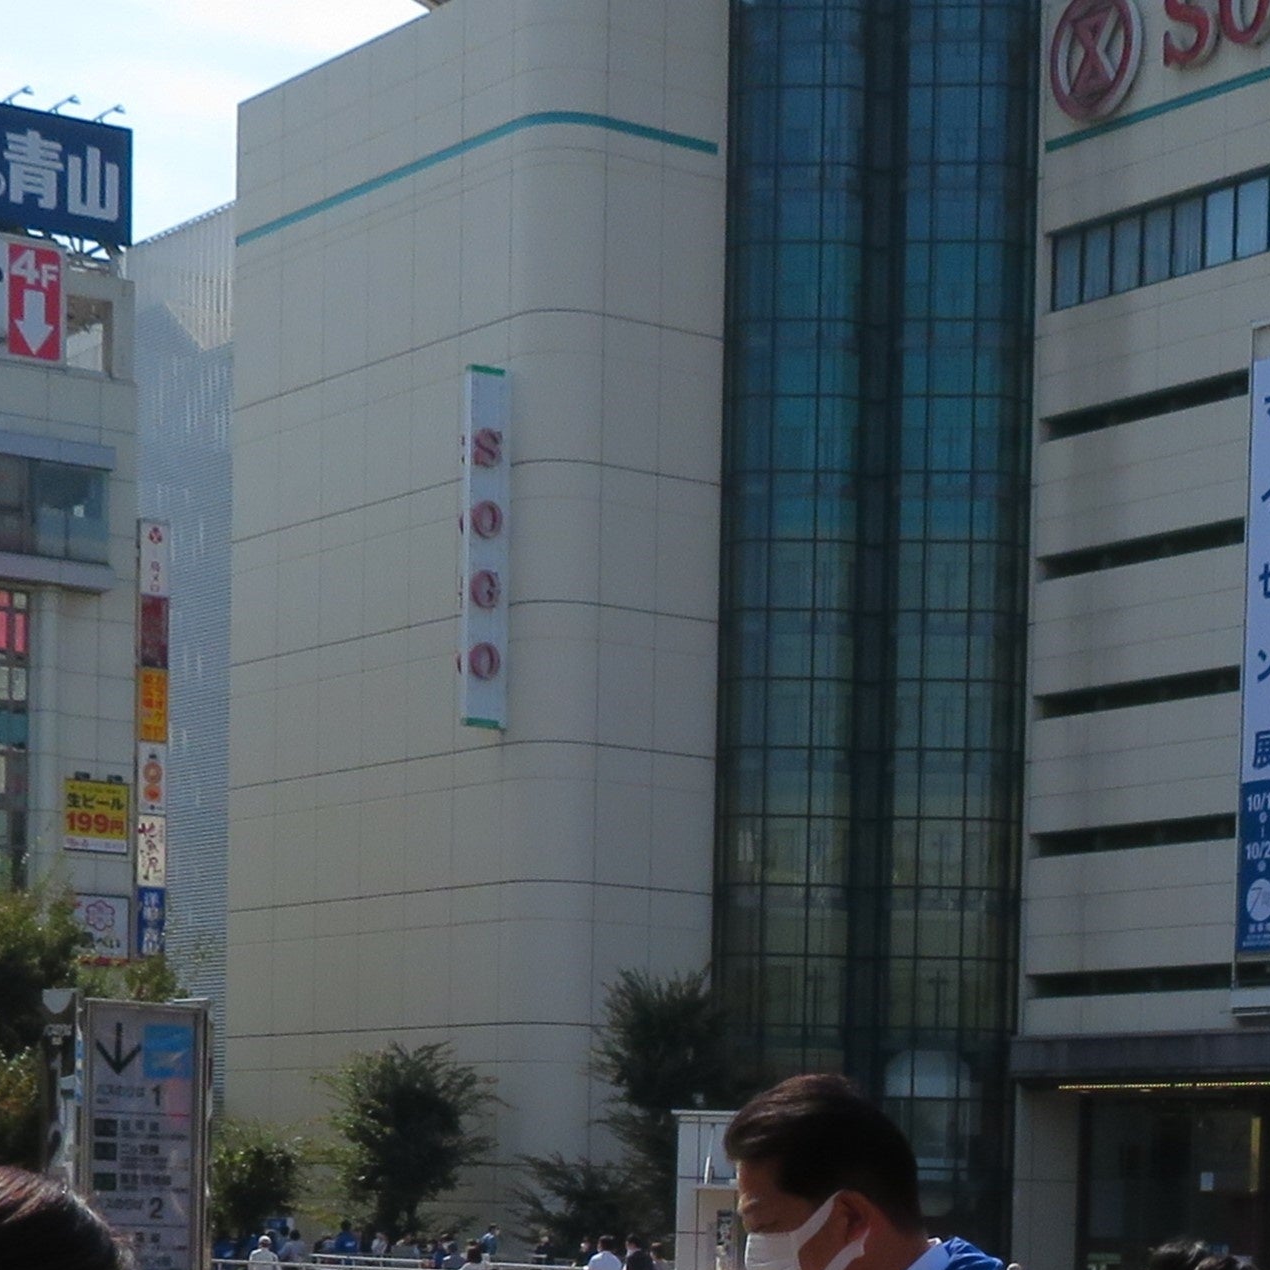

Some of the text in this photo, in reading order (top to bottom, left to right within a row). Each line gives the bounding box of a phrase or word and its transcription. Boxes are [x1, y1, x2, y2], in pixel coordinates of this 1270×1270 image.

[10, 249, 59, 288] 4F
[468, 427, 504, 682] SOGO
[66, 811, 124, 835] 199円
[152, 1084, 161, 1107] 1
[149, 1197, 164, 1219] 2
